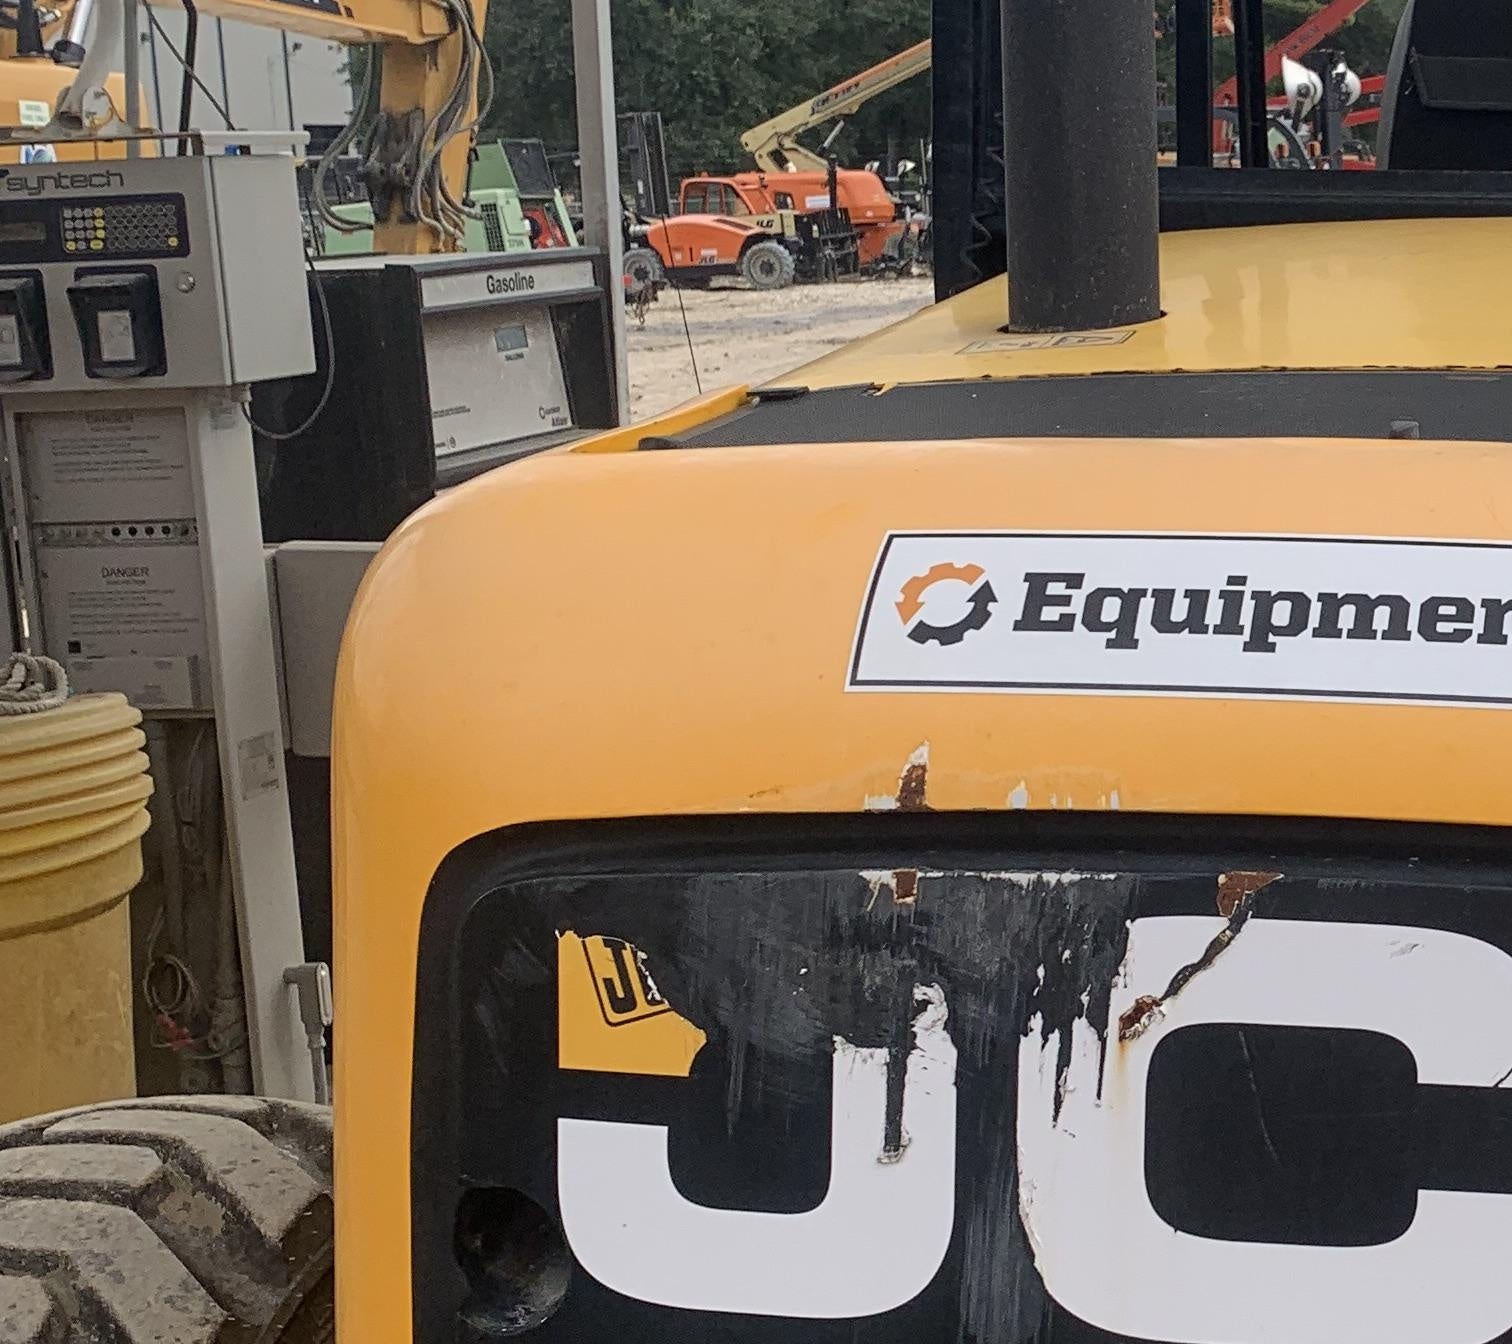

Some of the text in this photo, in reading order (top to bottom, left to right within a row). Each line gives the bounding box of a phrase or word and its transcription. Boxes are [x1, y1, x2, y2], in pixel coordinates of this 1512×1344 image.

[6, 170, 125, 196] syntech
[486, 272, 535, 294] Gasoline
[102, 567, 150, 579] DANGER
